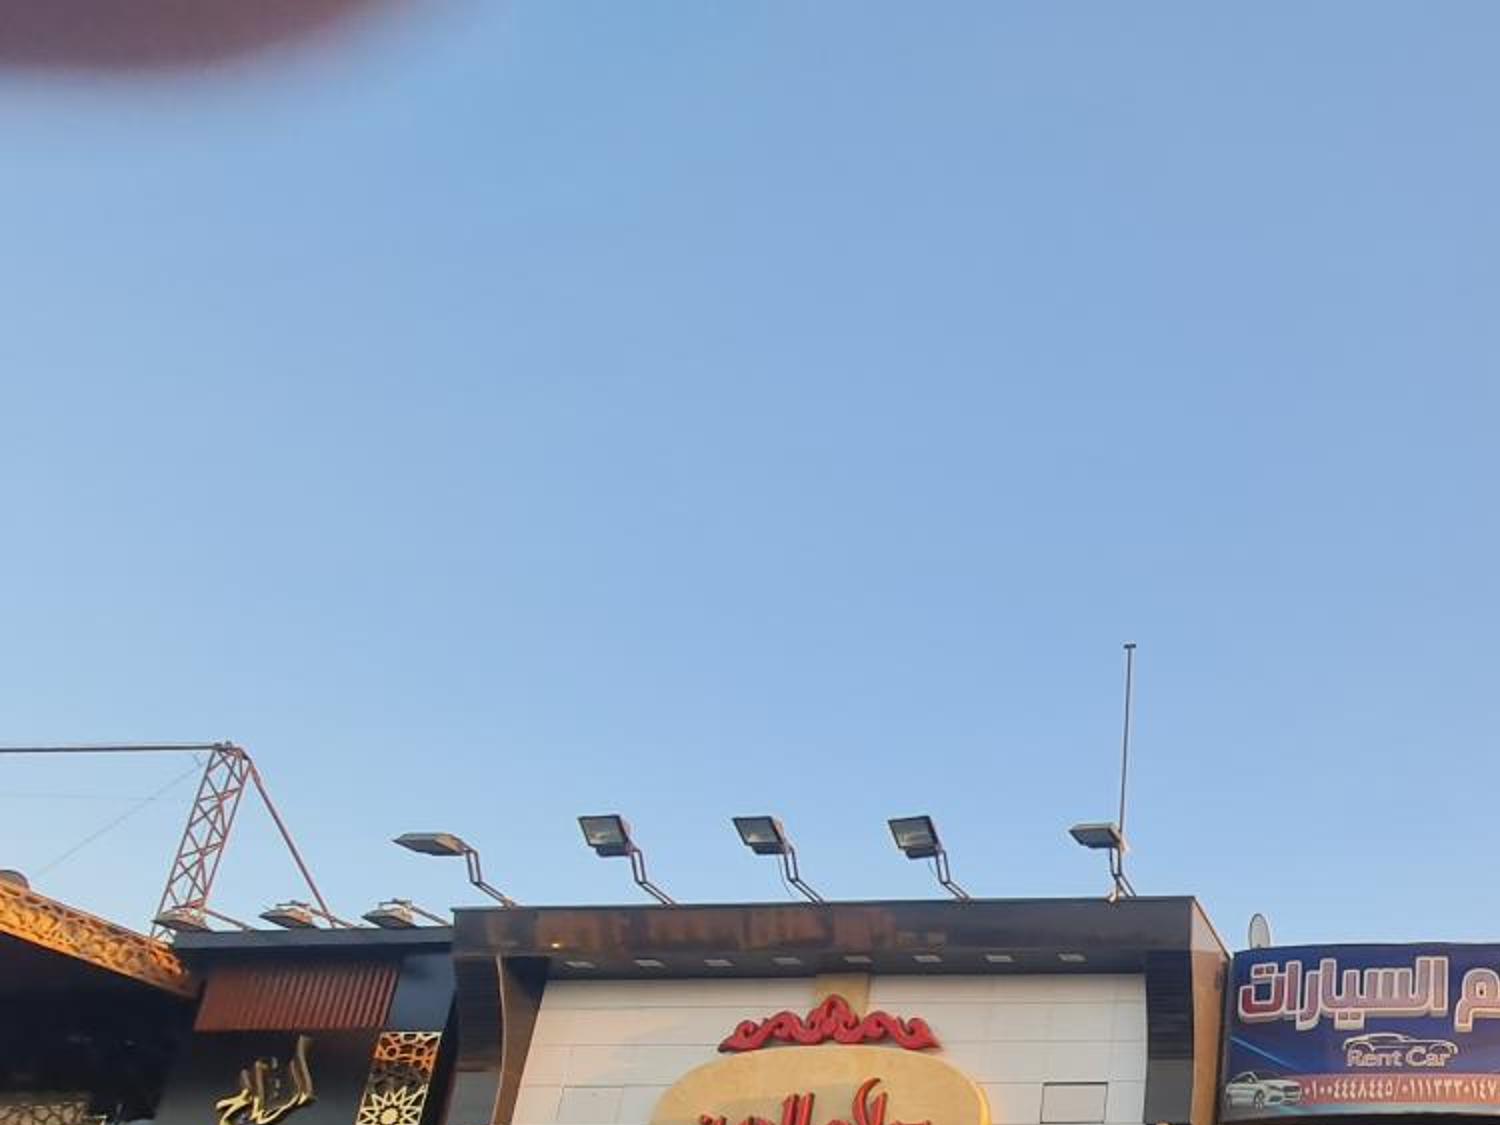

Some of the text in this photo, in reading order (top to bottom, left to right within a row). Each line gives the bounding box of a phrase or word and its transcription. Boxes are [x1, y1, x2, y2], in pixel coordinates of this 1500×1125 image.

[1238, 955, 1449, 1031] السيارات
[1346, 1046, 1452, 1068] Rent Car
